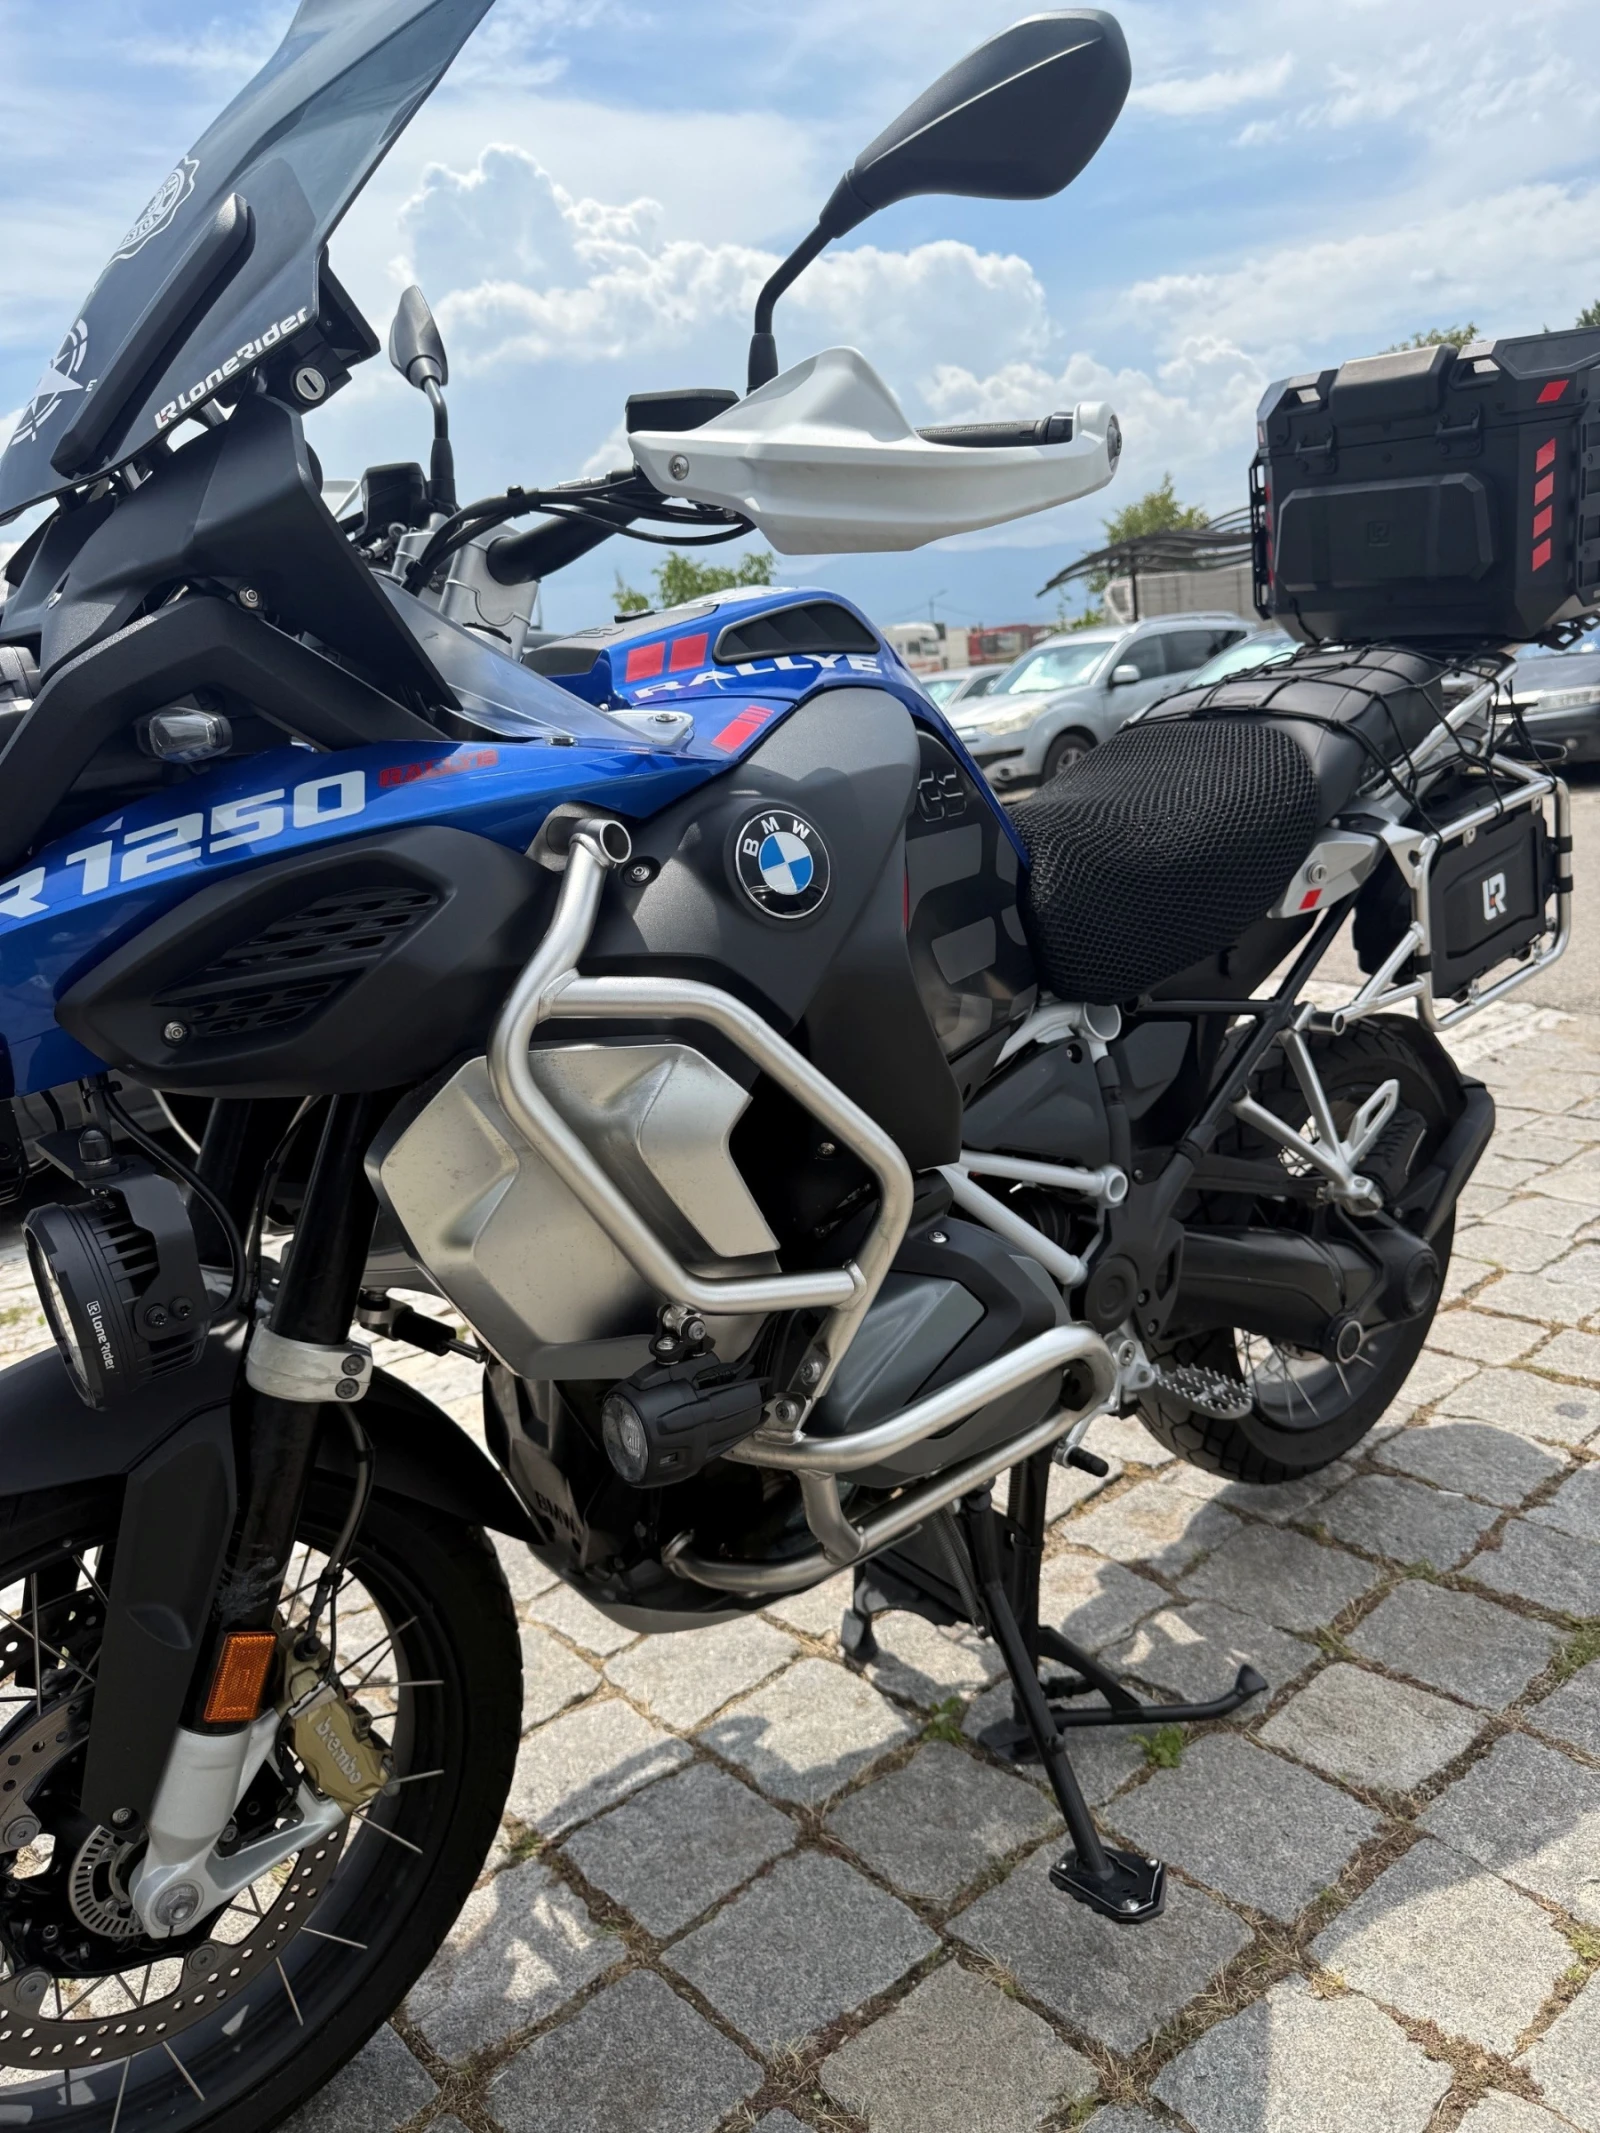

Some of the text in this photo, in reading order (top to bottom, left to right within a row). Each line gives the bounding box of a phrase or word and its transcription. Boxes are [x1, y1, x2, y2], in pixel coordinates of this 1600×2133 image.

[634, 654, 882, 700] RALLYE
[66, 770, 366, 895] 1250
[743, 816, 810, 857] BMW
[315, 1715, 362, 1784] brembo
